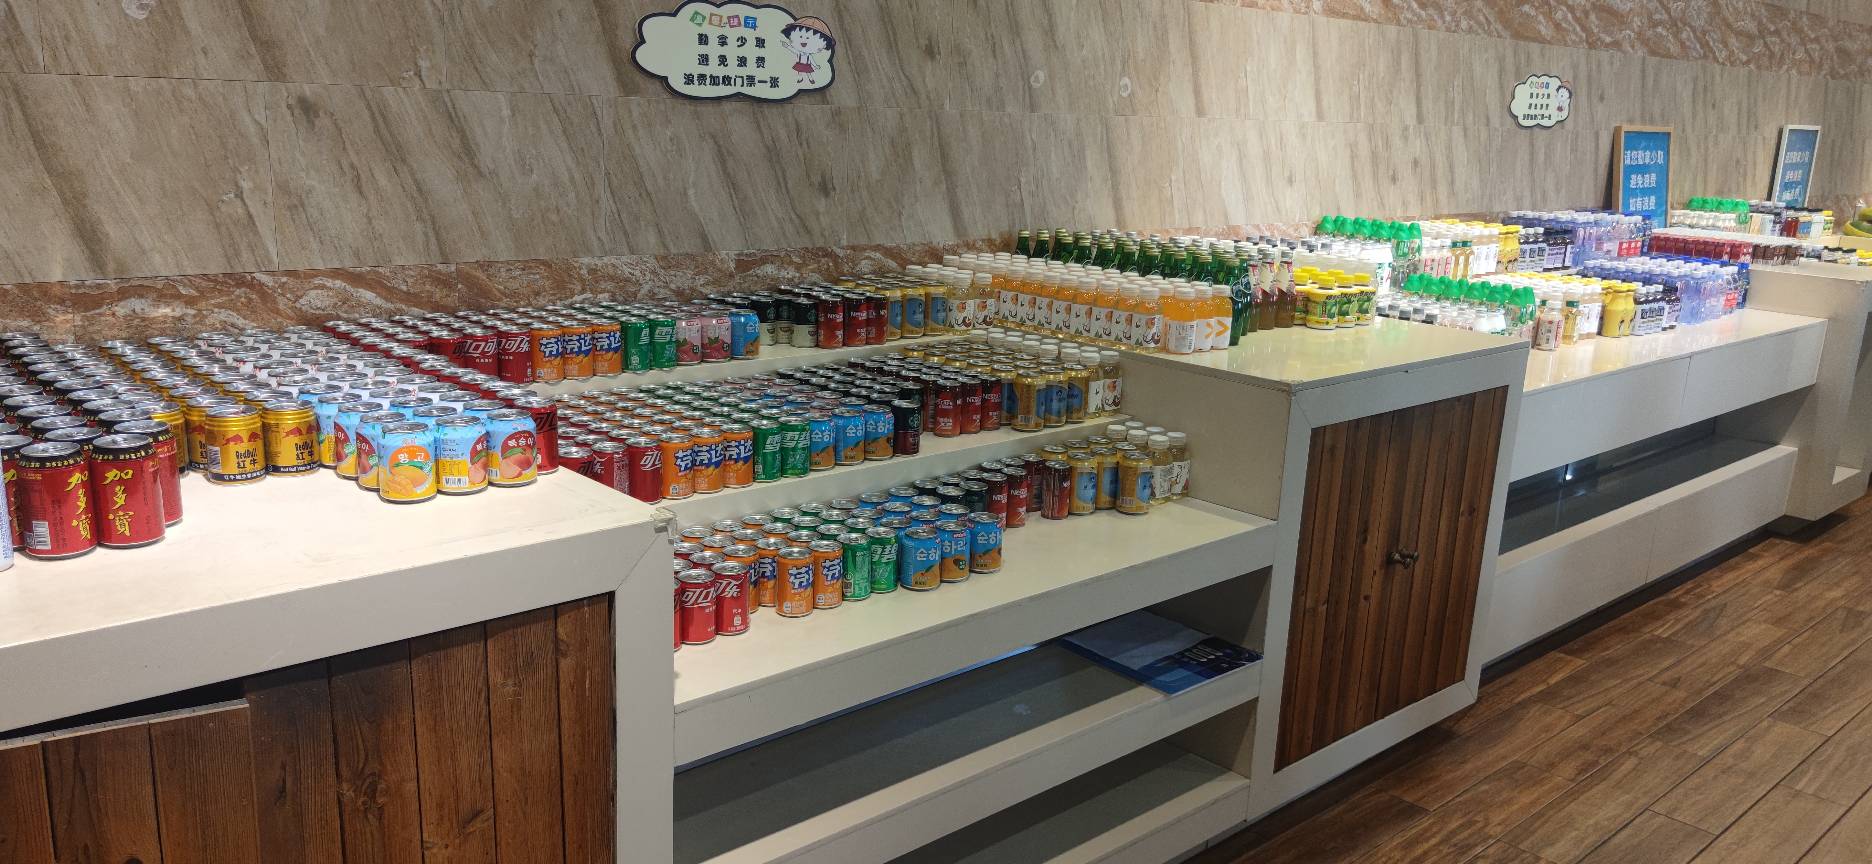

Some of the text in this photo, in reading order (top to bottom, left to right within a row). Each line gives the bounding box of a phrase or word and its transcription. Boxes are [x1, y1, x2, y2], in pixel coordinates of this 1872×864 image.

[697, 32, 766, 49] 勤拿少取
[697, 53, 766, 69] 避免浪费
[683, 73, 780, 88] 浪费加收门票一张
[397, 452, 425, 463] 망고
[693, 443, 724, 465] 芬达
[237, 457, 258, 468] 红牛
